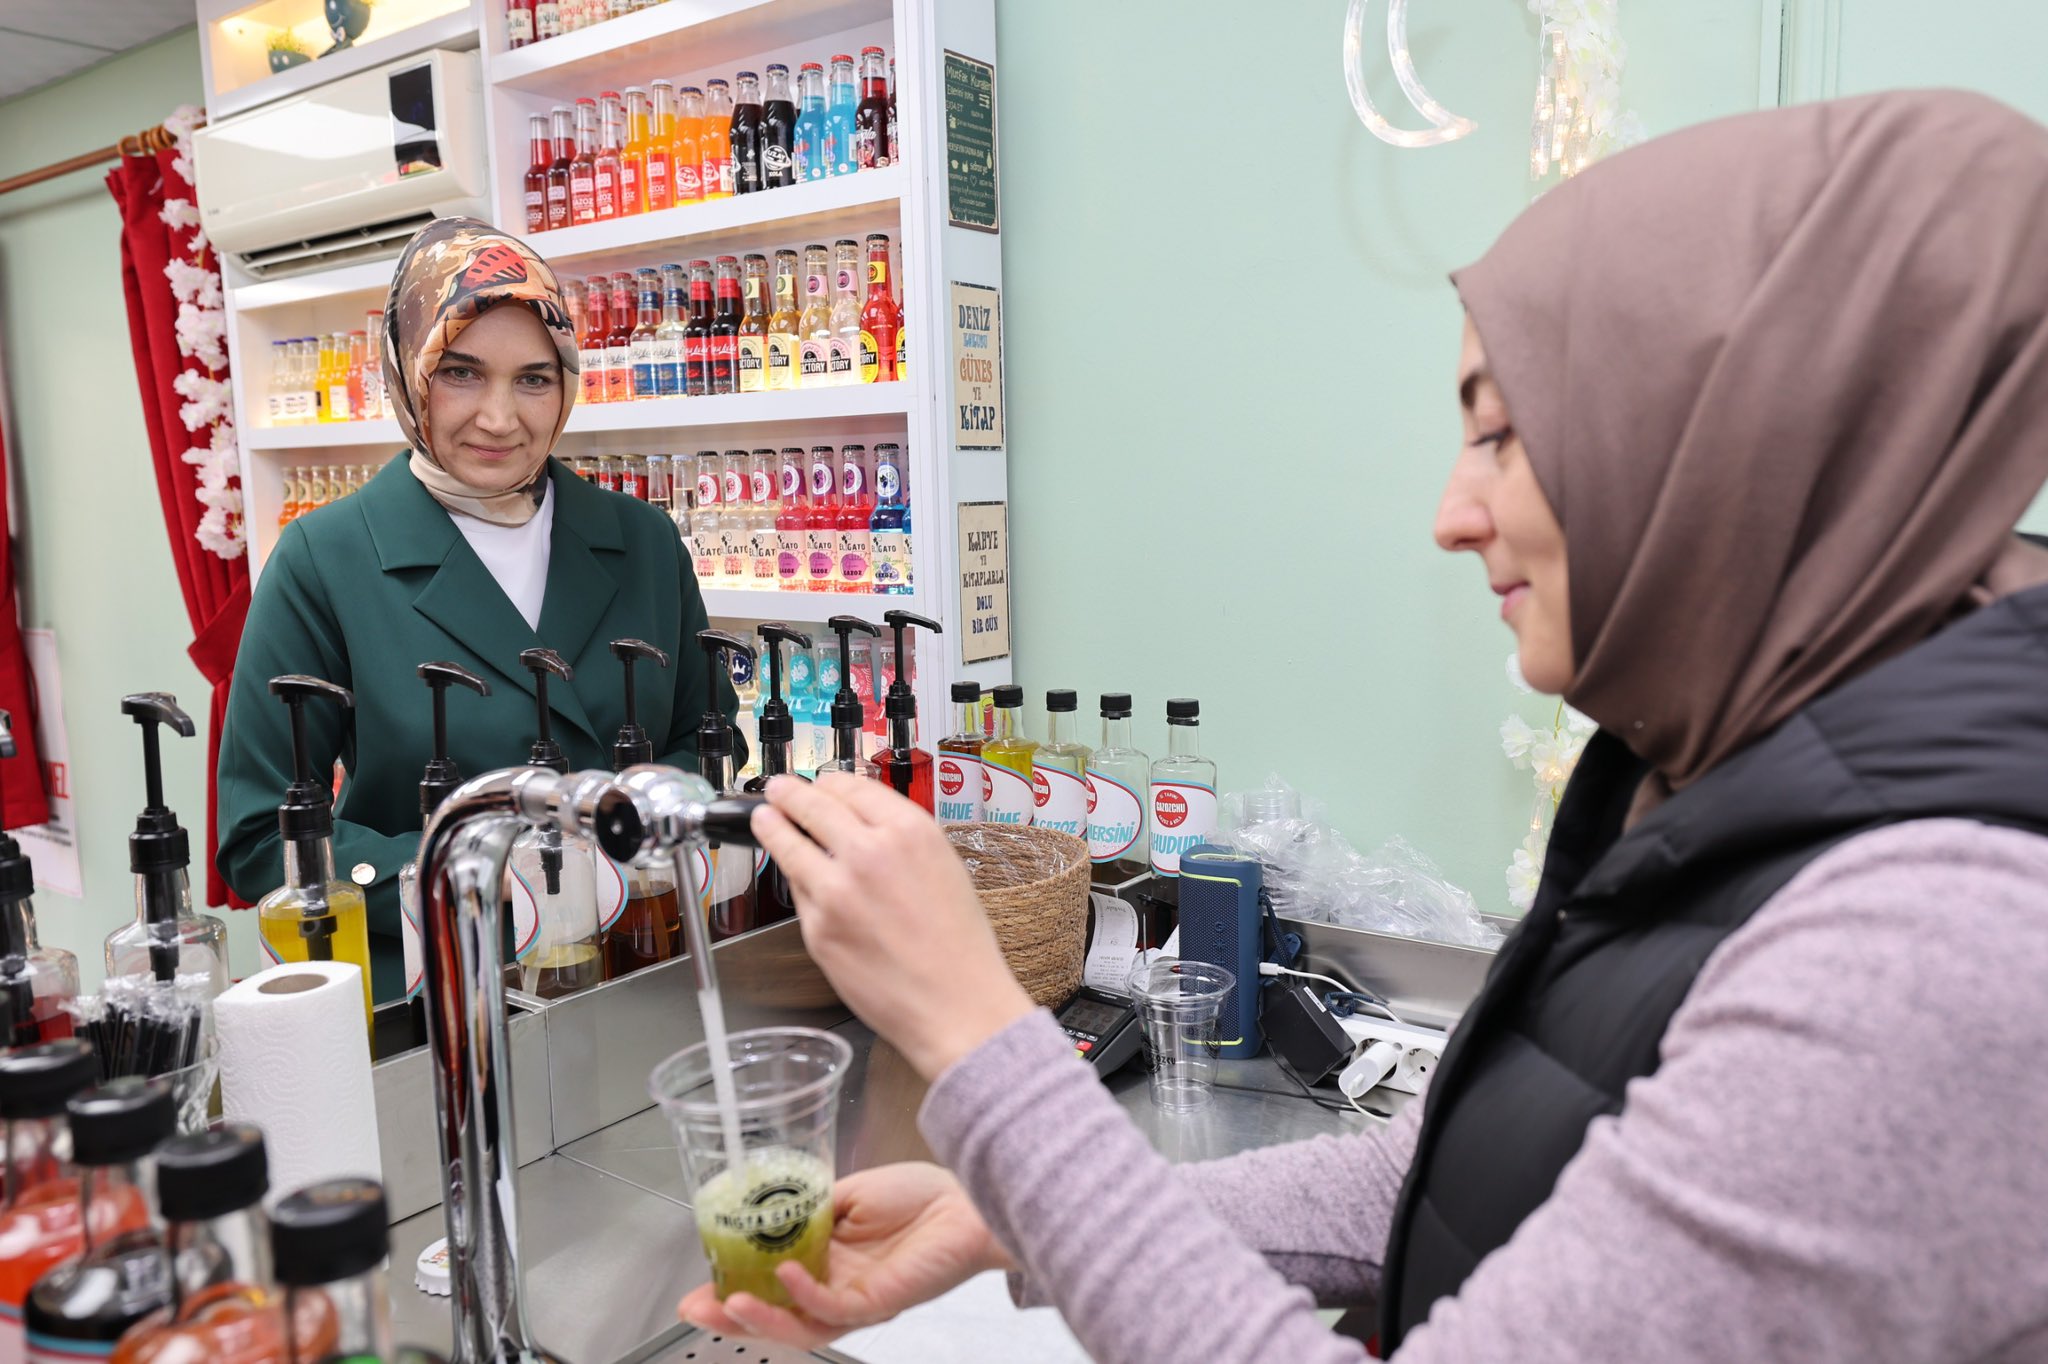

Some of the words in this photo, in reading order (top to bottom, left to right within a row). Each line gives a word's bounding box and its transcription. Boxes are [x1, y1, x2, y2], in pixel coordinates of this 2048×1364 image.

[958, 304, 991, 331] DENİZ
[960, 354, 992, 389] GÜNEŞ
[960, 404, 995, 431] KİTAP
[814, 542, 832, 550] GATO
[847, 543, 866, 551] GATO
[878, 544, 896, 552] GATO
[968, 531, 998, 552] KAHVE
[962, 569, 1005, 588] KİTAPLARLA
[976, 595, 993, 611] DOLU
[972, 618, 984, 634] BİR
[985, 614, 998, 632] GÜN
[1156, 801, 1186, 813] GAZOZCHU
[1151, 832, 1205, 855] HUDUD
